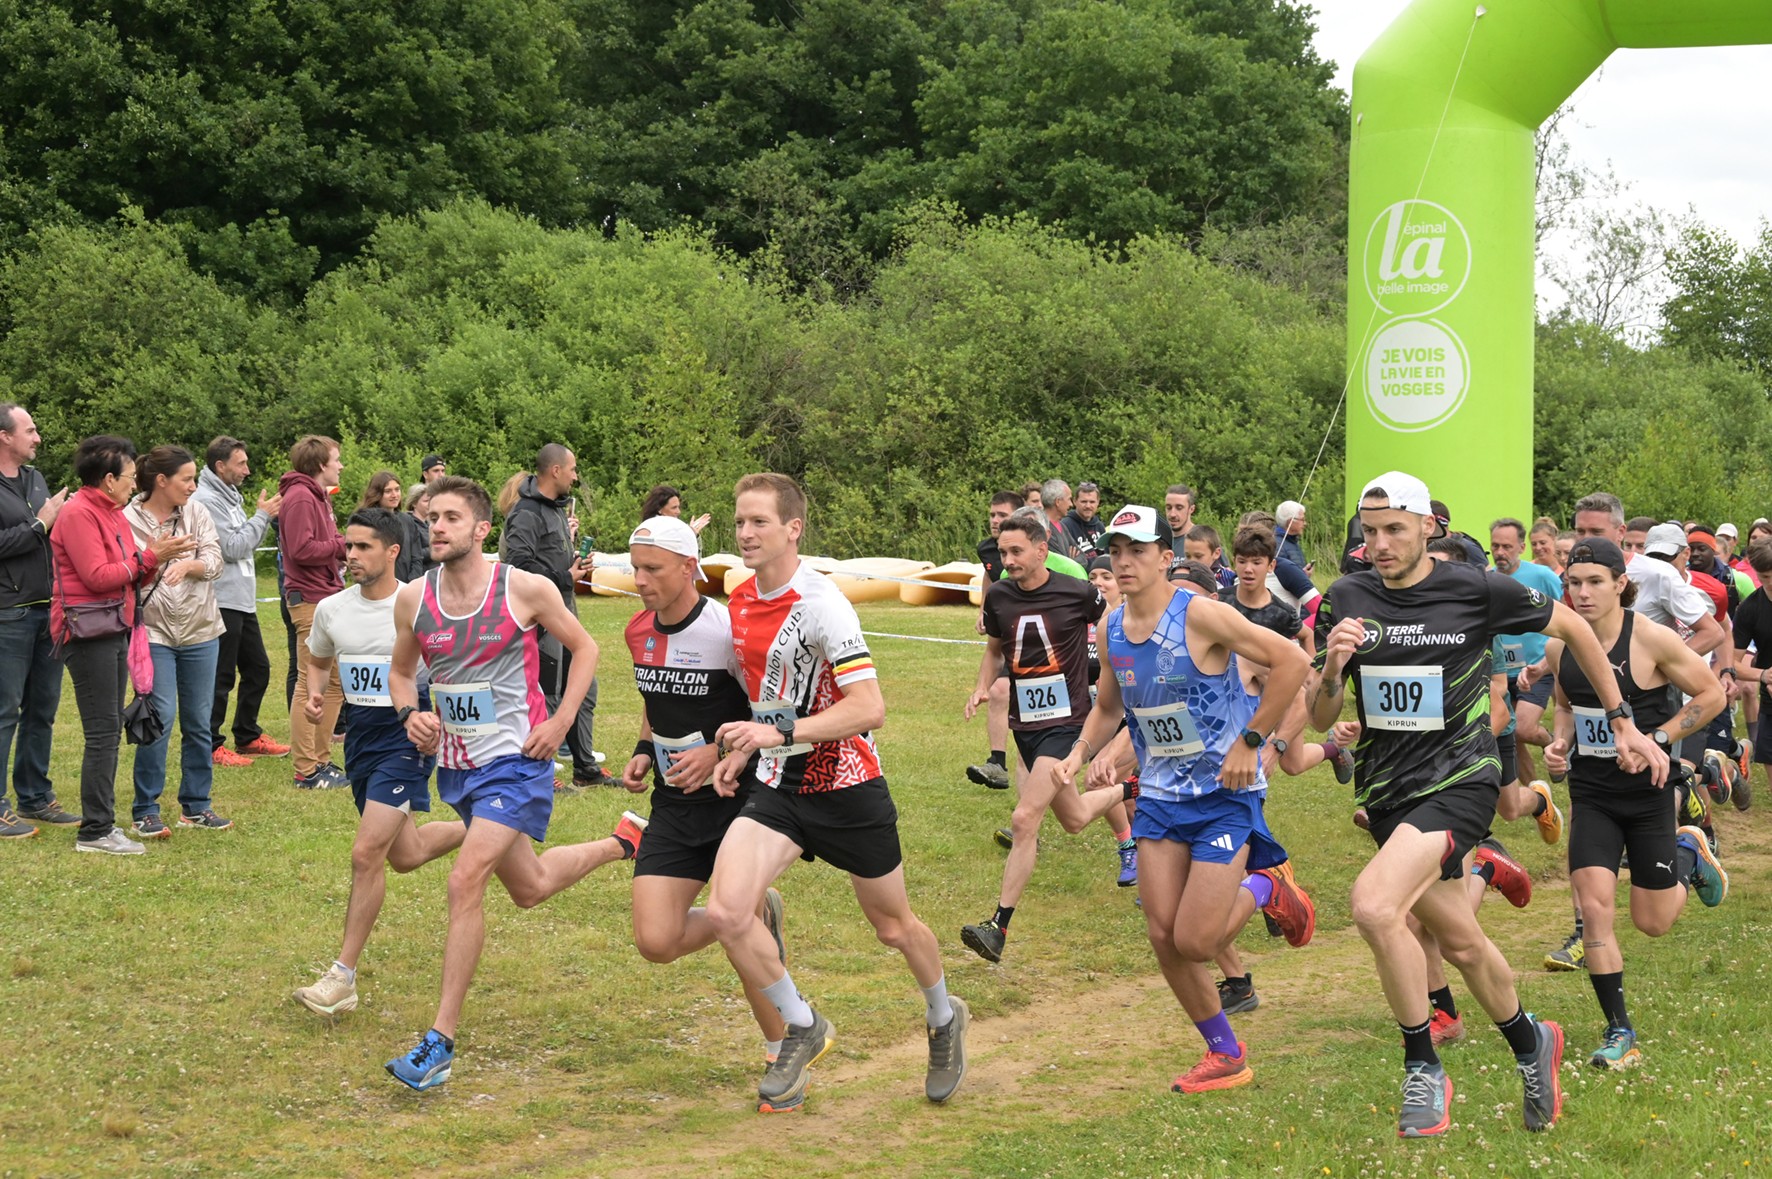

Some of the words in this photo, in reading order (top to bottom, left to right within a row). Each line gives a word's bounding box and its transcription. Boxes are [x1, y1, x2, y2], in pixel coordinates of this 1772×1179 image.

[1404, 220, 1447, 236] épinal
[1379, 201, 1446, 281] la
[1377, 282, 1404, 295] belle
[1407, 281, 1449, 296] image
[1381, 348, 1401, 364] JE
[1403, 347, 1446, 363] VOIS
[1381, 366, 1399, 380] LA
[1399, 366, 1423, 379] VIE
[1381, 383, 1446, 397] VOSGES
[779, 611, 802, 646] Club
[1386, 624, 1426, 636] TERRE
[1390, 635, 1402, 644] DE
[1402, 633, 1466, 646] RUNNING
[350, 666, 382, 692] 394
[634, 667, 709, 685] TRIATHLON
[637, 681, 669, 694] PINAL
[672, 684, 710, 696] CLUB
[1378, 681, 1423, 713] 309
[1026, 686, 1057, 710] 326
[445, 695, 480, 722] 364
[1147, 716, 1184, 744] 333
[1493, 853, 1522, 873] SALOMON
